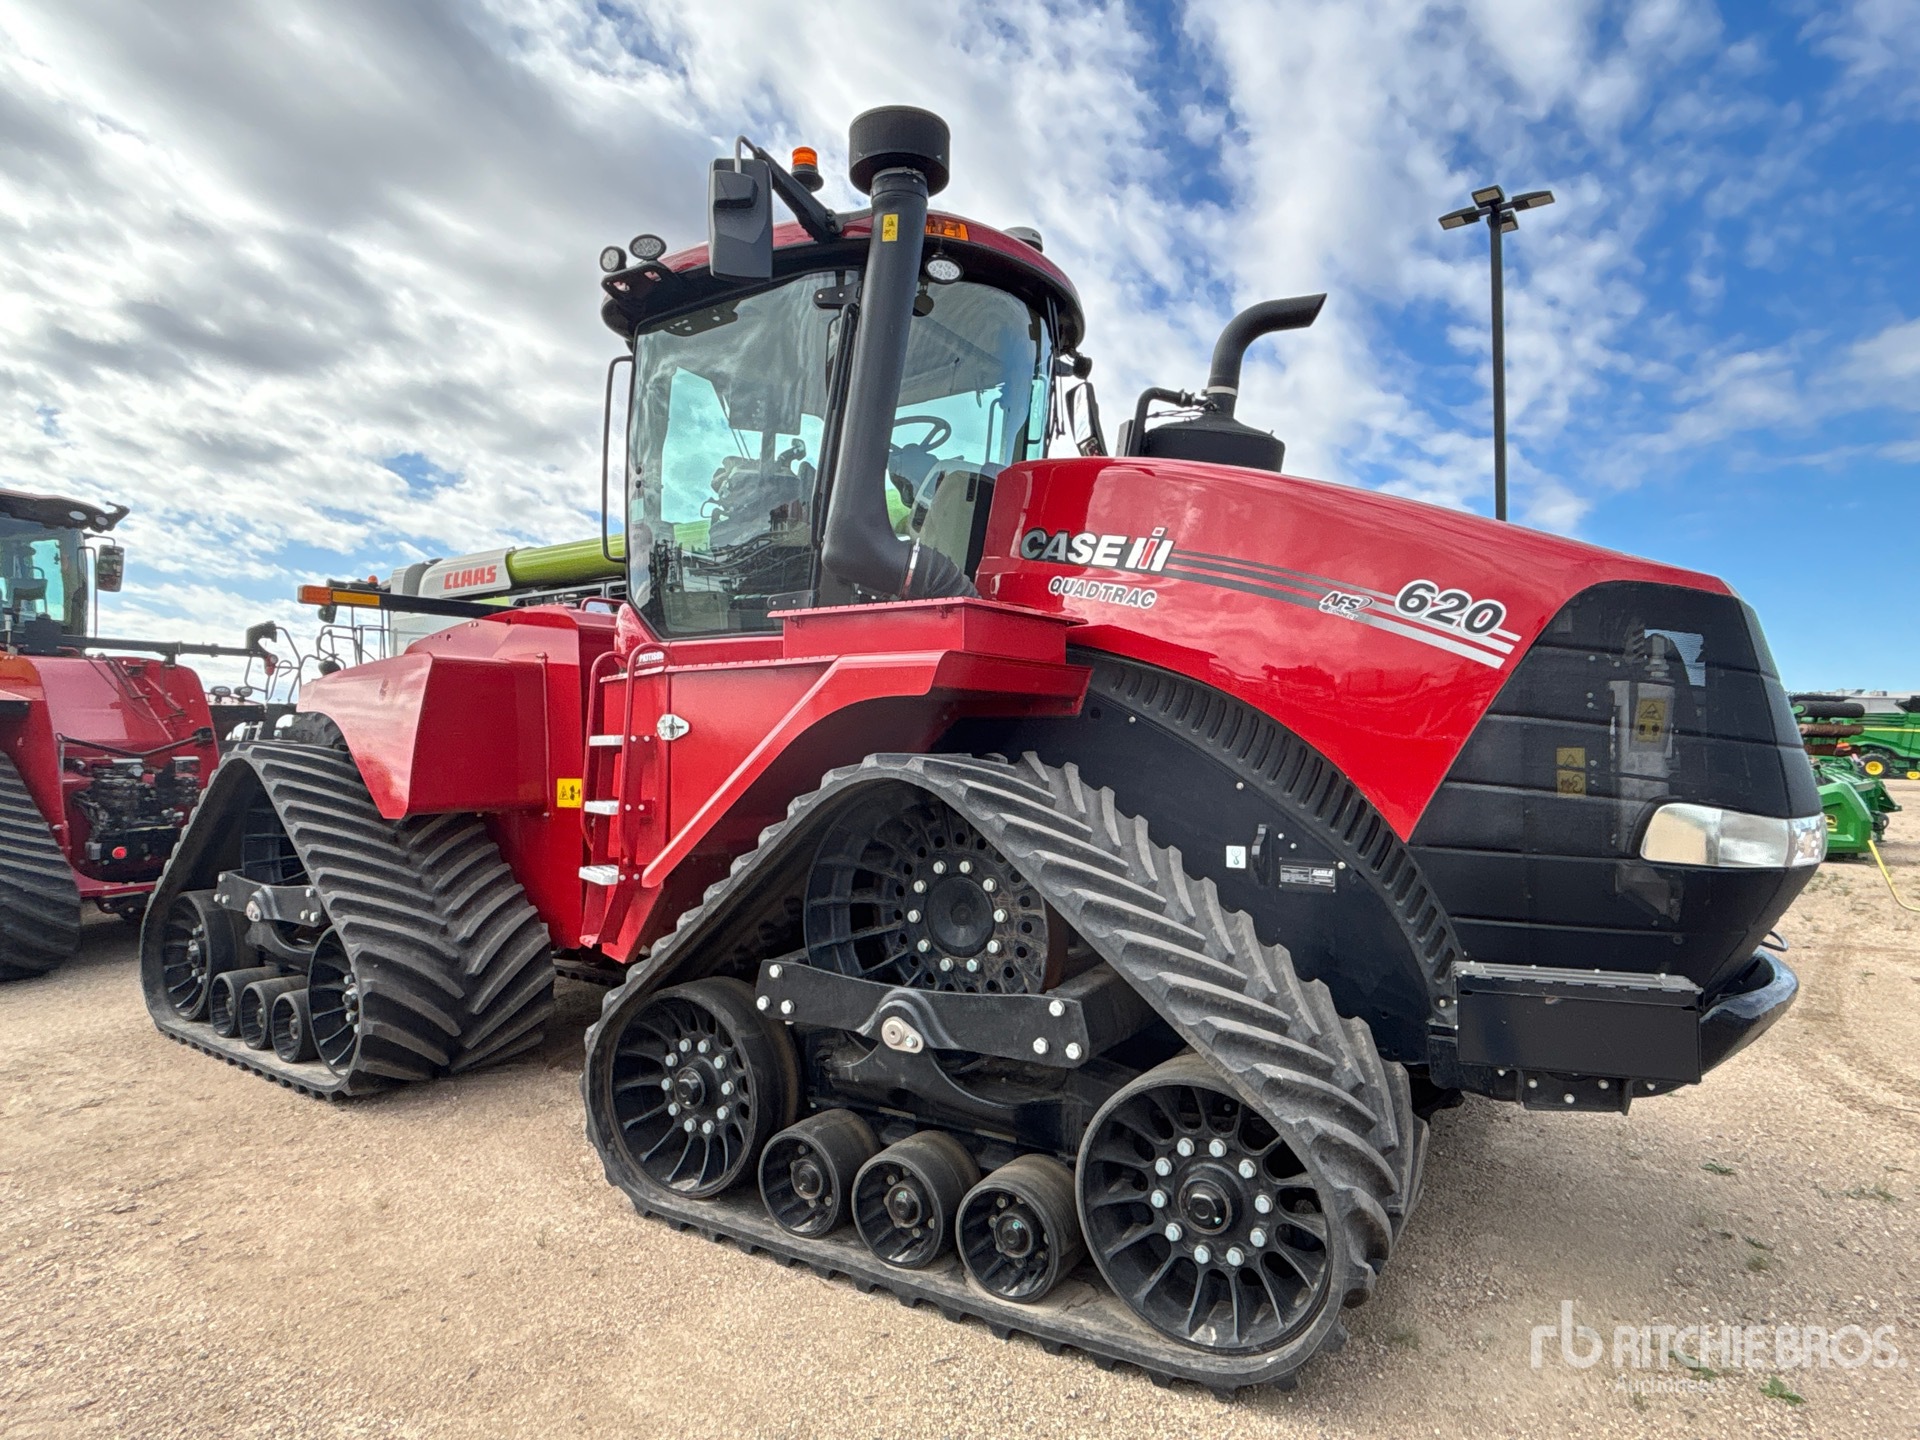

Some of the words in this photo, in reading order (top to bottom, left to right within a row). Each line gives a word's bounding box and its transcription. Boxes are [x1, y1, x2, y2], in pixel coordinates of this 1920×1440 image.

[1021, 529, 1127, 567] CASE
[443, 565, 497, 590] CLAAS
[1049, 577, 1157, 608] QUADTRAC
[1321, 591, 1361, 610] AFS
[1396, 580, 1506, 636] 620
